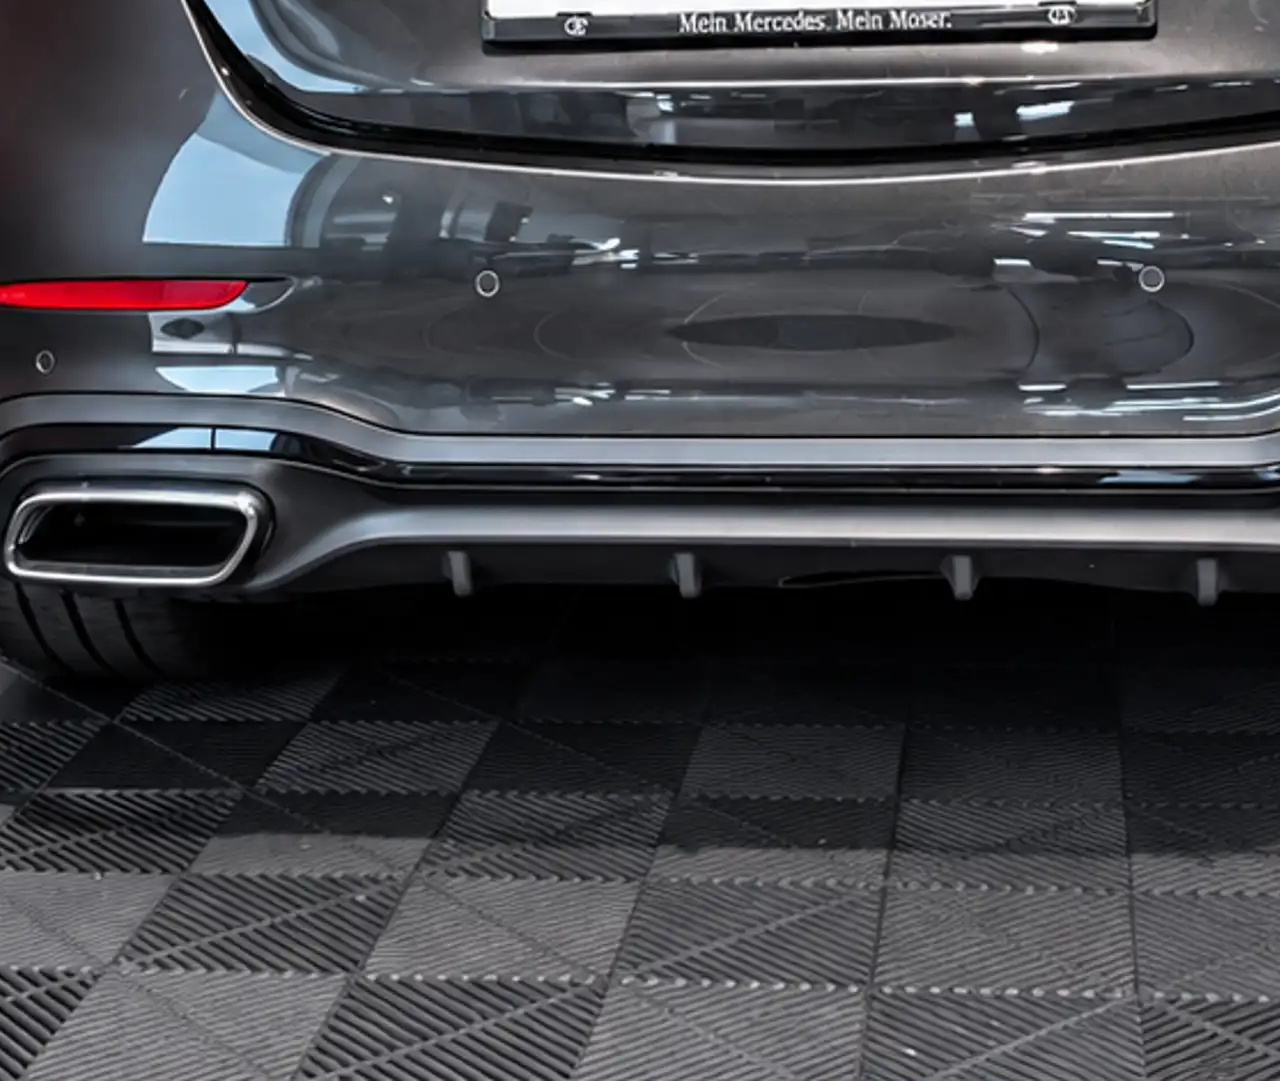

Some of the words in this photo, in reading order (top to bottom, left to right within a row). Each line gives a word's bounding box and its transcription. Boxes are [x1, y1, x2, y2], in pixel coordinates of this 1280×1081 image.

[679, 11, 728, 33] Mein
[836, 9, 882, 30] Mein
[889, 9, 952, 29] Moser.
